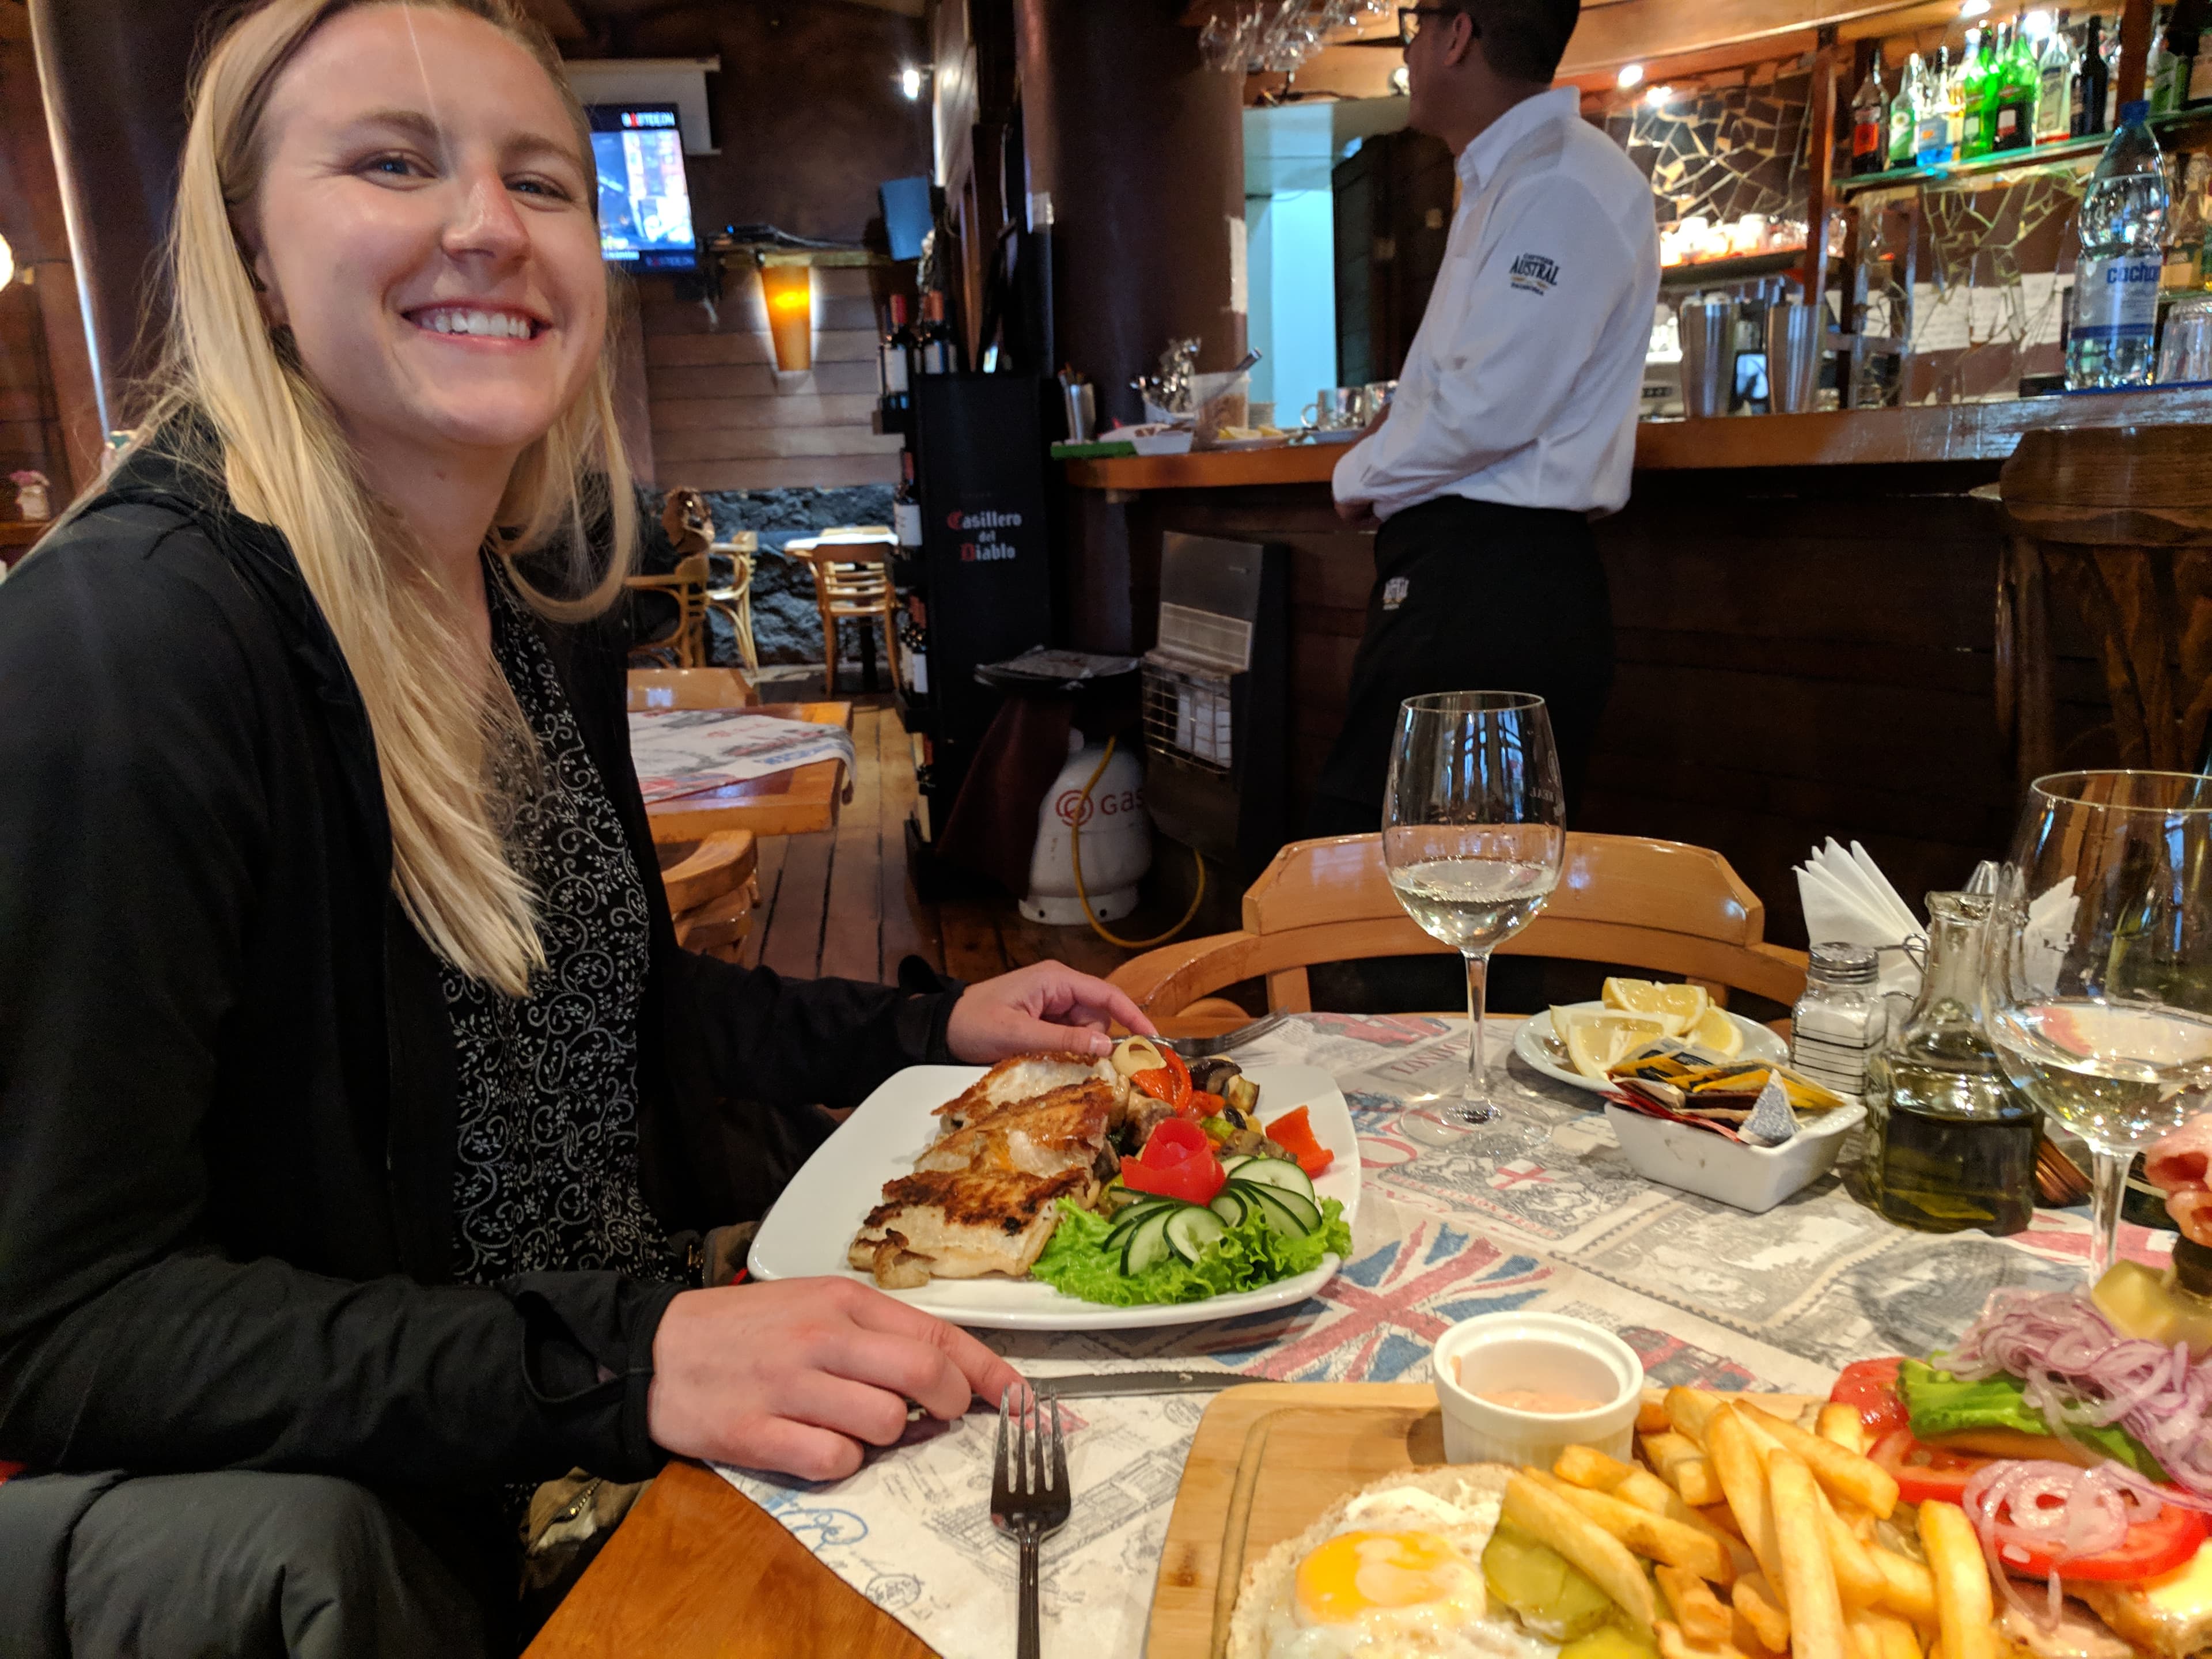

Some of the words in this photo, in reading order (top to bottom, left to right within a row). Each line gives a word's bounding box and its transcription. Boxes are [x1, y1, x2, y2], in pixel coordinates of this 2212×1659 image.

[1509, 255, 1559, 286] AUSTRAL
[947, 509, 1022, 530] Casillero
[960, 543, 1016, 562] Diablo
